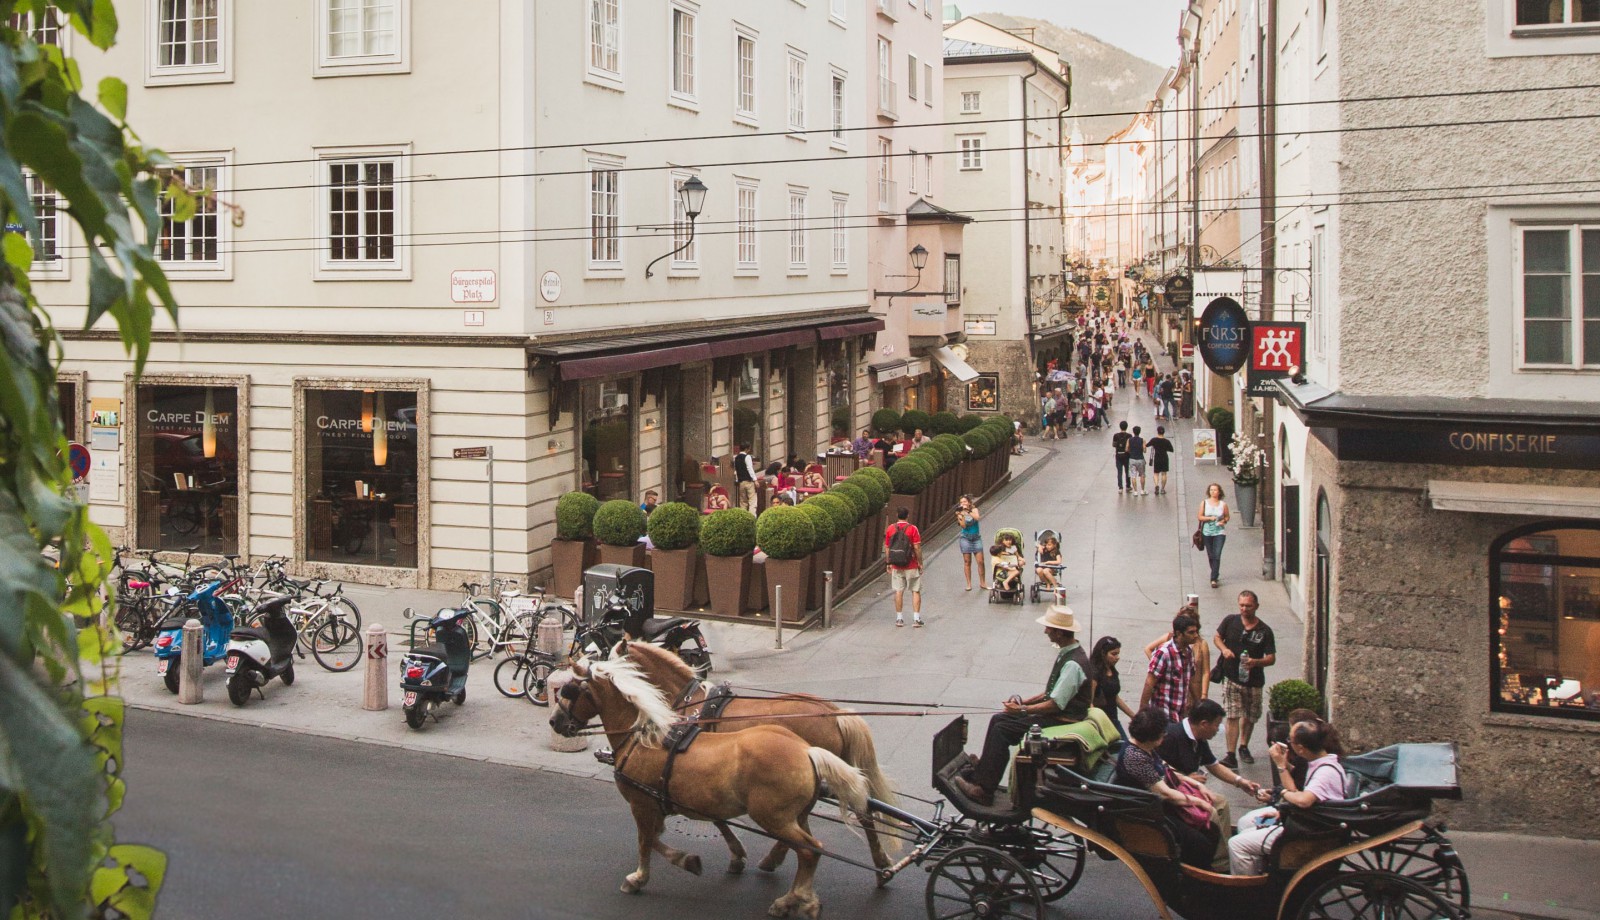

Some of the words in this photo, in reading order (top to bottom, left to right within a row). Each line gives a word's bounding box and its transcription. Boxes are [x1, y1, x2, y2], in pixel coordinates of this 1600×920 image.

[1202, 325, 1246, 341] FÜRST
[147, 410, 191, 423] CARPE
[195, 411, 229, 425] DIEM
[316, 415, 363, 430] CARPE
[369, 417, 407, 431] DIEM
[1450, 432, 1556, 453] CONFISERIE
